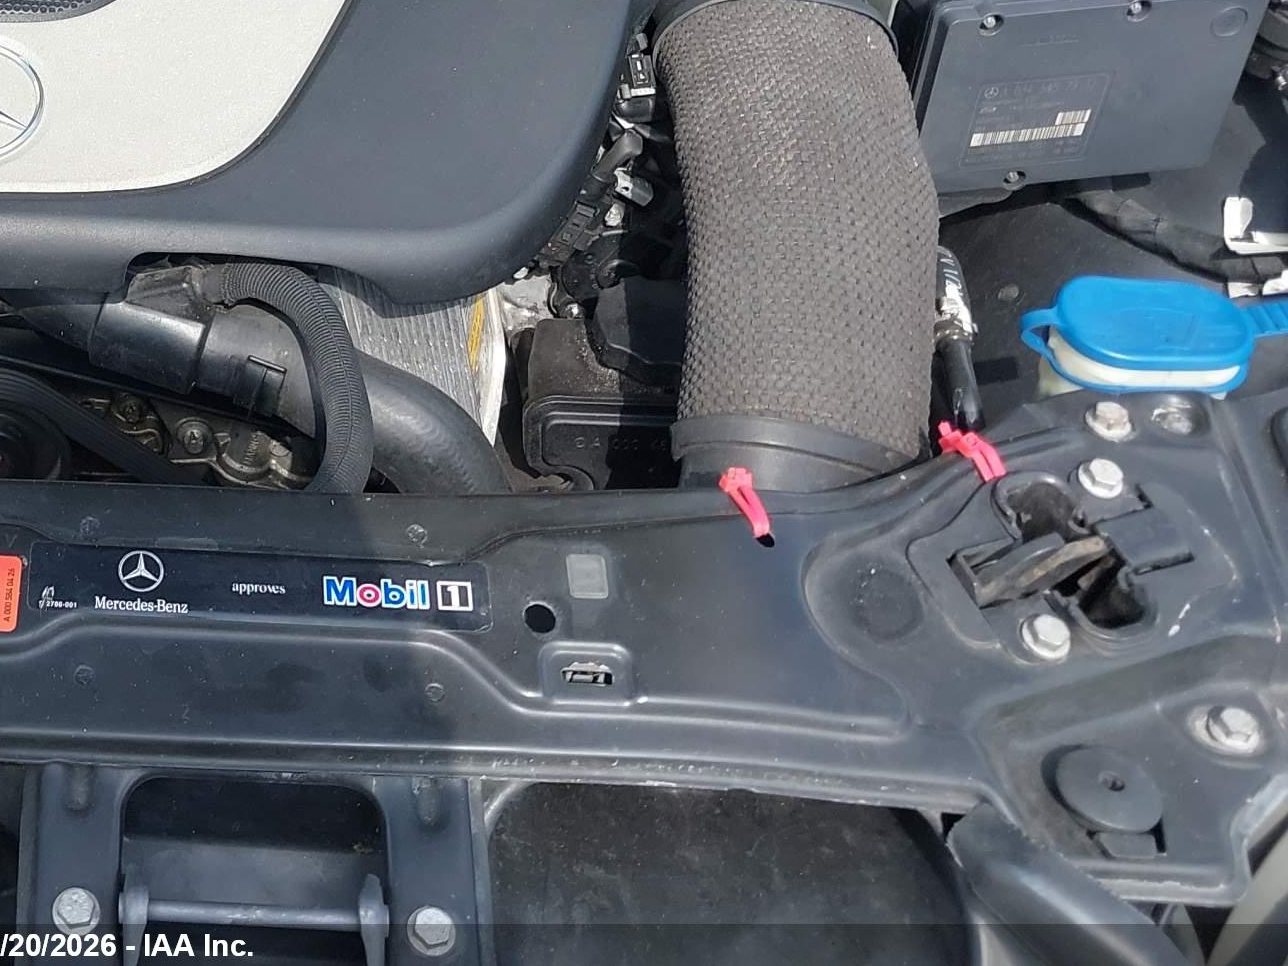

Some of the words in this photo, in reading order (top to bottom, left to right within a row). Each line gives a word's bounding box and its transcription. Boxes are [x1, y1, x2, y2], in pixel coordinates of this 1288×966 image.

[94, 596, 189, 614] Mercedes-Benz
[231, 581, 286, 595] approves
[323, 576, 430, 610] Mobil
